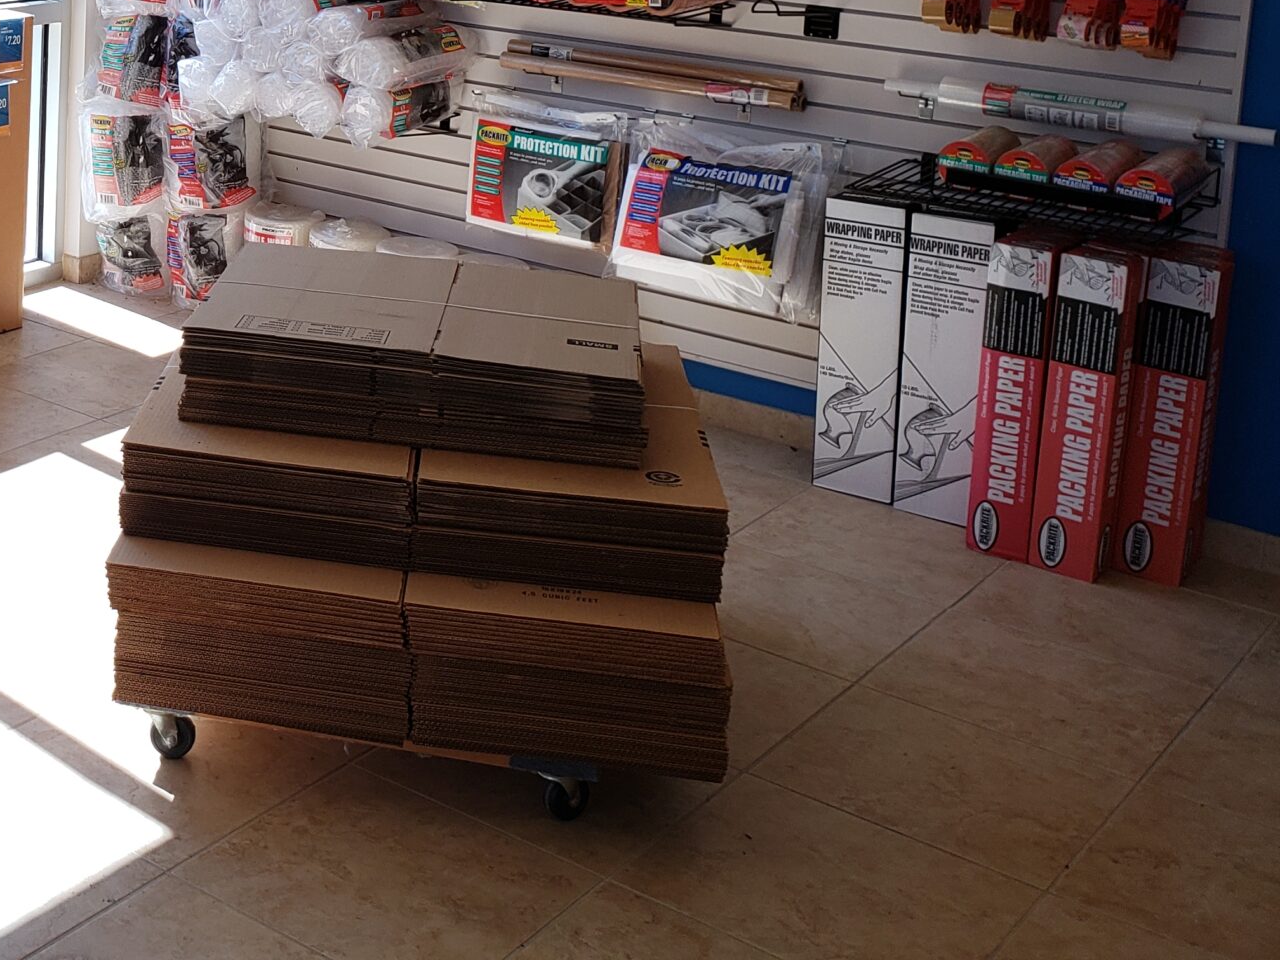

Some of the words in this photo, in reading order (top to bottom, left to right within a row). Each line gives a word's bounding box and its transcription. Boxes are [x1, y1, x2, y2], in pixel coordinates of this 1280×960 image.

[5, 34, 21, 45] $7.20
[1096, 99, 1125, 109] WRAP
[480, 129, 509, 142] PACKRITE
[513, 135, 578, 160] PROTECTION
[580, 144, 605, 163] KIT
[680, 162, 756, 188] PROTECTION
[758, 174, 788, 192] KIT
[939, 158, 973, 171] PACKAGING
[974, 163, 990, 174] TAPE
[994, 167, 1030, 181] PACKAGING
[1032, 173, 1048, 183] TAPE
[1053, 176, 1090, 190] PACKAGING
[1092, 183, 1108, 193] TAPE
[1116, 187, 1154, 201] PACKAGING
[1156, 196, 1174, 206] TAPE
[826, 221, 873, 239] WRAPPING
[874, 228, 902, 244] PAPER
[910, 236, 960, 256] WRAPPING
[961, 245, 991, 262] PAPER
[994, 355, 1026, 418] PAPER
[1065, 369, 1099, 434] PAPER
[1153, 373, 1189, 439] PAPER
[987, 418, 1021, 505] PACKING
[1055, 434, 1092, 523] PACKING
[1141, 439, 1180, 528] PACKING
[979, 503, 992, 545] PACKRITE
[1045, 521, 1060, 563] PACKRITE
